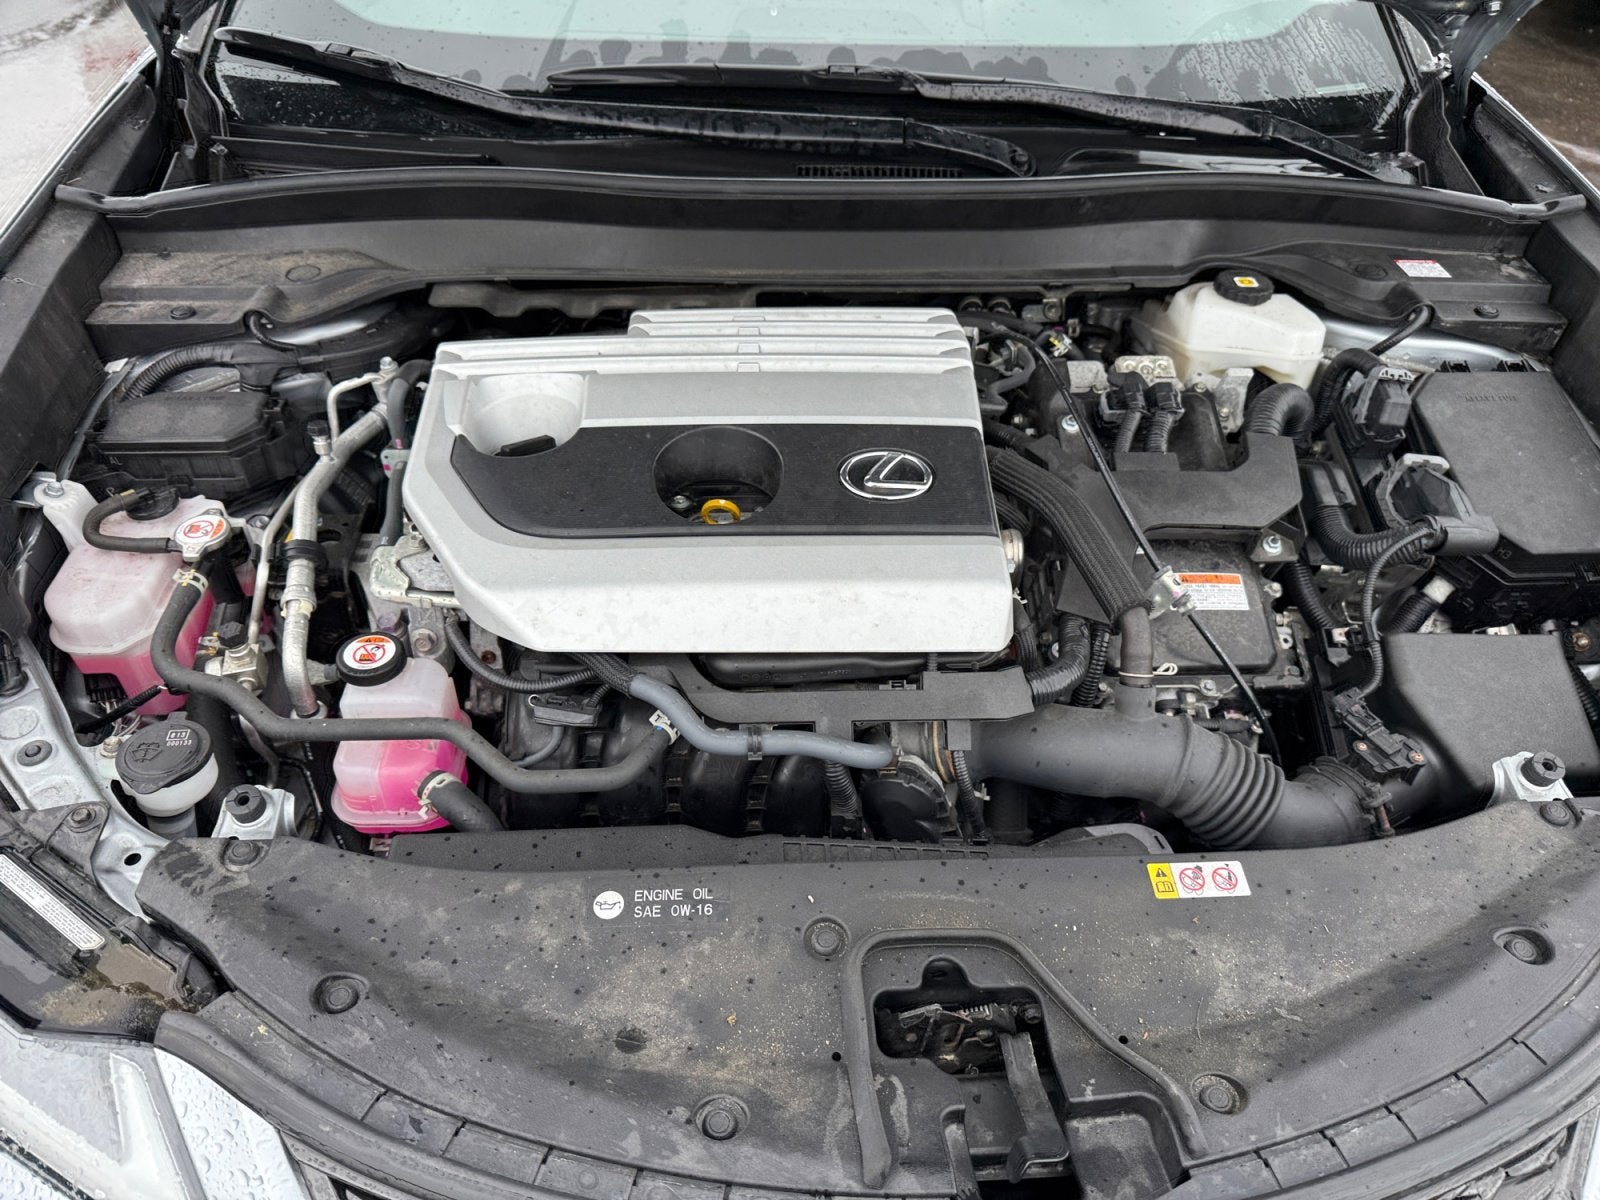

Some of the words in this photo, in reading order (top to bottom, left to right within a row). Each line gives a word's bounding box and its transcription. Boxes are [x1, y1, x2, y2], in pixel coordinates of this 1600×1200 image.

[634, 888, 683, 901] ENGINE
[692, 888, 713, 900] OIL
[633, 905, 661, 918] SAE
[670, 904, 713, 916] 0W-16
